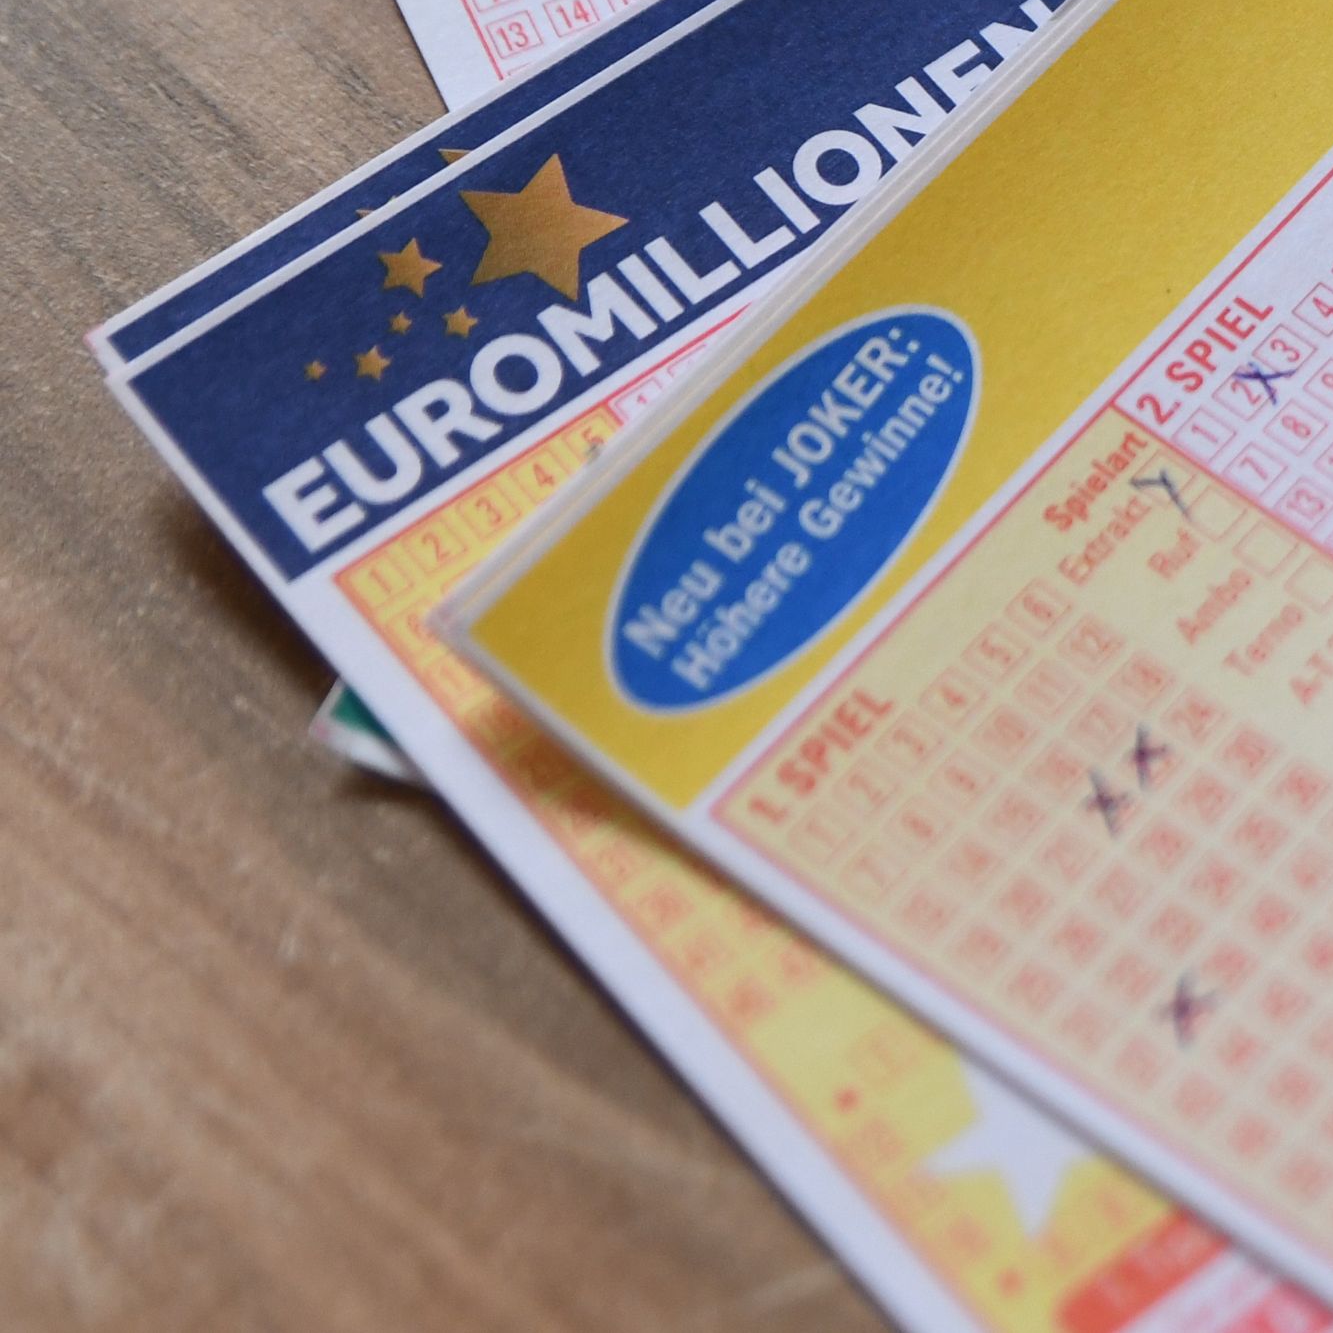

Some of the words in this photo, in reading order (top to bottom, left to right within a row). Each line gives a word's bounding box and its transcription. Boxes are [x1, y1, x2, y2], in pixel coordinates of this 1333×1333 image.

[496, 21, 530, 52] 13
[1136, 393, 1182, 426] 2.
[1165, 296, 1274, 394] SPIEL
[421, 532, 450, 562] 2
[475, 496, 504, 525] 3
[531, 462, 556, 488] 4
[624, 561, 724, 658] Neu
[705, 480, 787, 562] bei
[771, 323, 922, 486] JOKER:
[671, 542, 812, 692] Höhere
[799, 351, 965, 541] Gewinne!
[1043, 428, 1148, 531] Spielart
[1057, 494, 1152, 587] Extrakt
[777, 688, 893, 793] SPIEL
